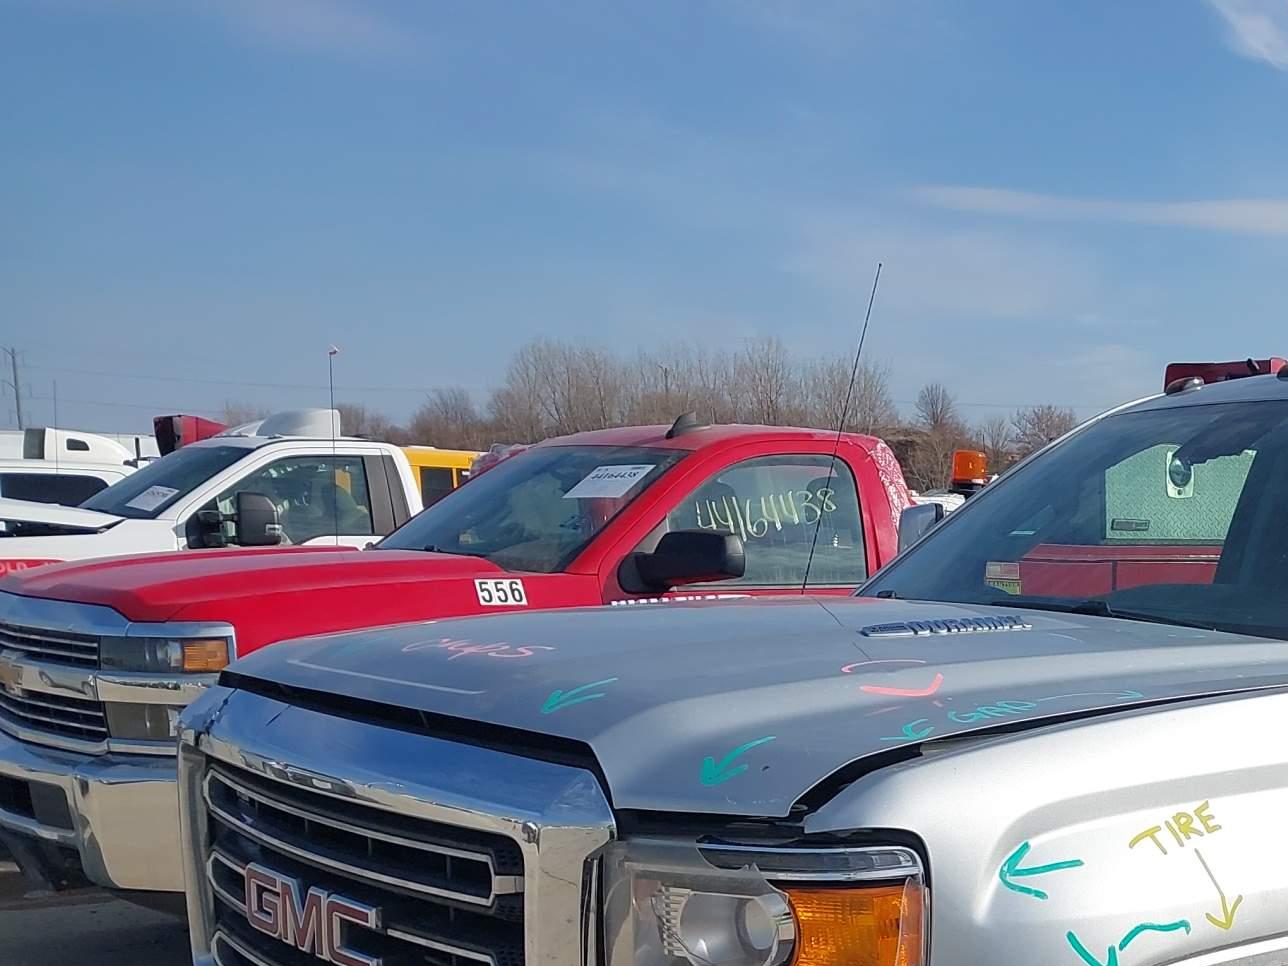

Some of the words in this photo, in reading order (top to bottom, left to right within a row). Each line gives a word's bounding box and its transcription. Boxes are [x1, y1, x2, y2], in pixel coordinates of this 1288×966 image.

[695, 488, 837, 542] 44164438
[478, 581, 523, 603] 556
[1129, 800, 1222, 855] TIRE
